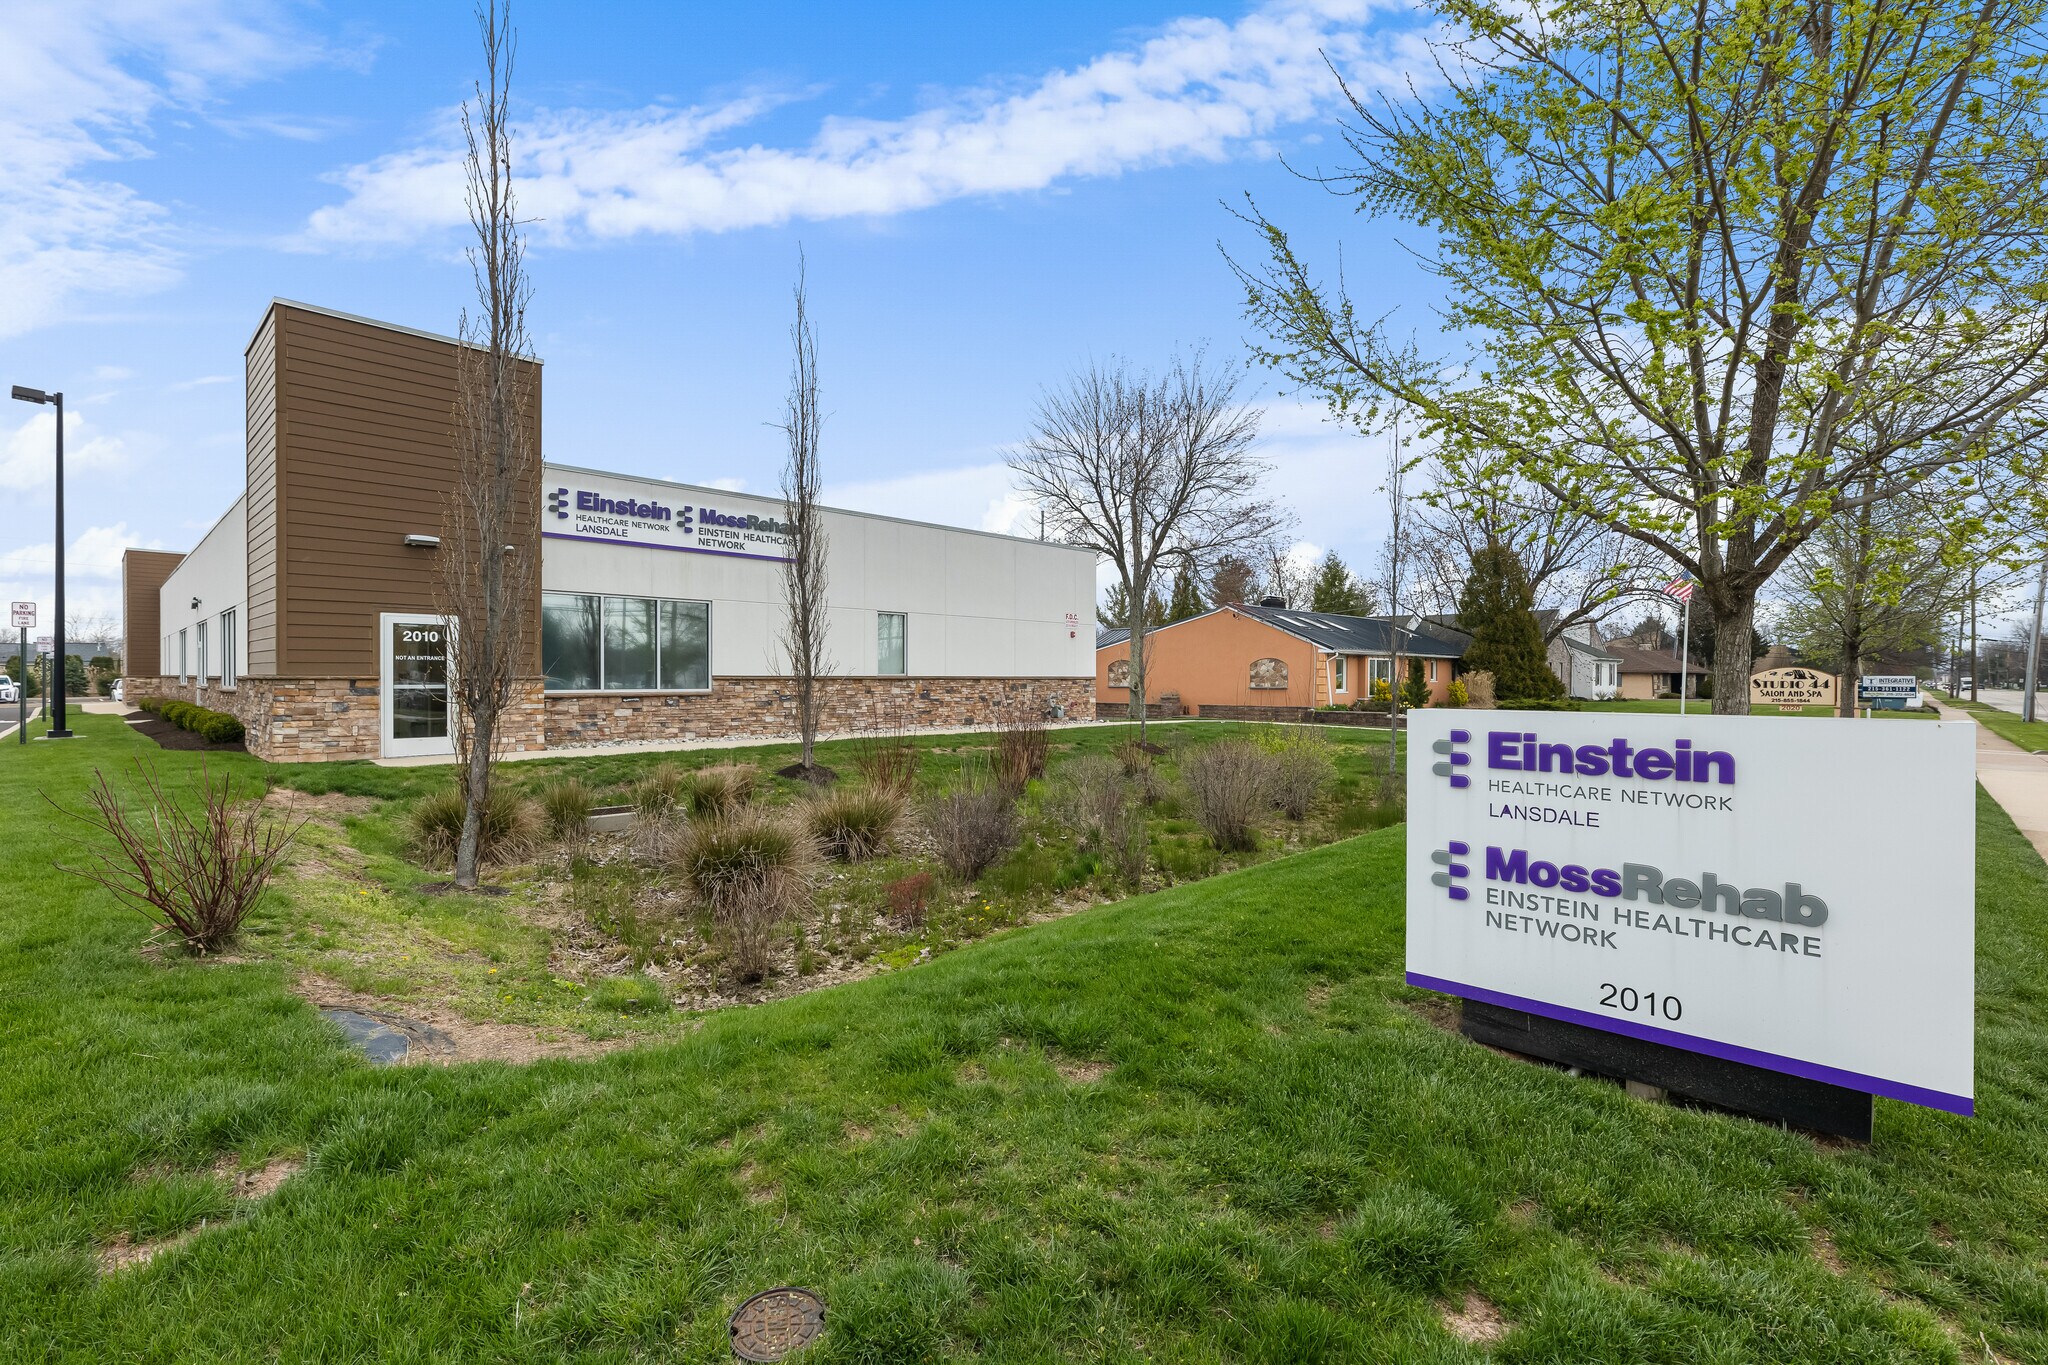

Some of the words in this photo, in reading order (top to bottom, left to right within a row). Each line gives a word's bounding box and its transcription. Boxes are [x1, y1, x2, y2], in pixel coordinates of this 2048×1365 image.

[577, 490, 671, 521] Einstein
[575, 513, 629, 527] HEALTHCARE
[631, 520, 670, 532] NETWORK
[576, 523, 628, 538] LANSDALE
[698, 527, 740, 540] EINSTEIN
[743, 532, 799, 547] HEALTHCARE
[698, 537, 746, 550] NETWORK
[402, 631, 438, 642] 2010
[1752, 679, 1805, 689] STUDIO
[1808, 679, 1831, 689] 44
[1760, 689, 1785, 697] SALON
[1807, 689, 1823, 698] SPA
[1488, 731, 1736, 785] Einstein
[1488, 779, 1612, 802] HEALTHCARE
[1621, 789, 1733, 812] NETWORK
[1489, 803, 1600, 828] LANSDALE
[1485, 845, 1829, 928] MossRehab
[1485, 887, 1600, 922] EINSTEIN
[1613, 907, 1822, 958] HEALTHCARE
[1485, 910, 1618, 950] NETWORK
[1599, 983, 1683, 1021] 2010
